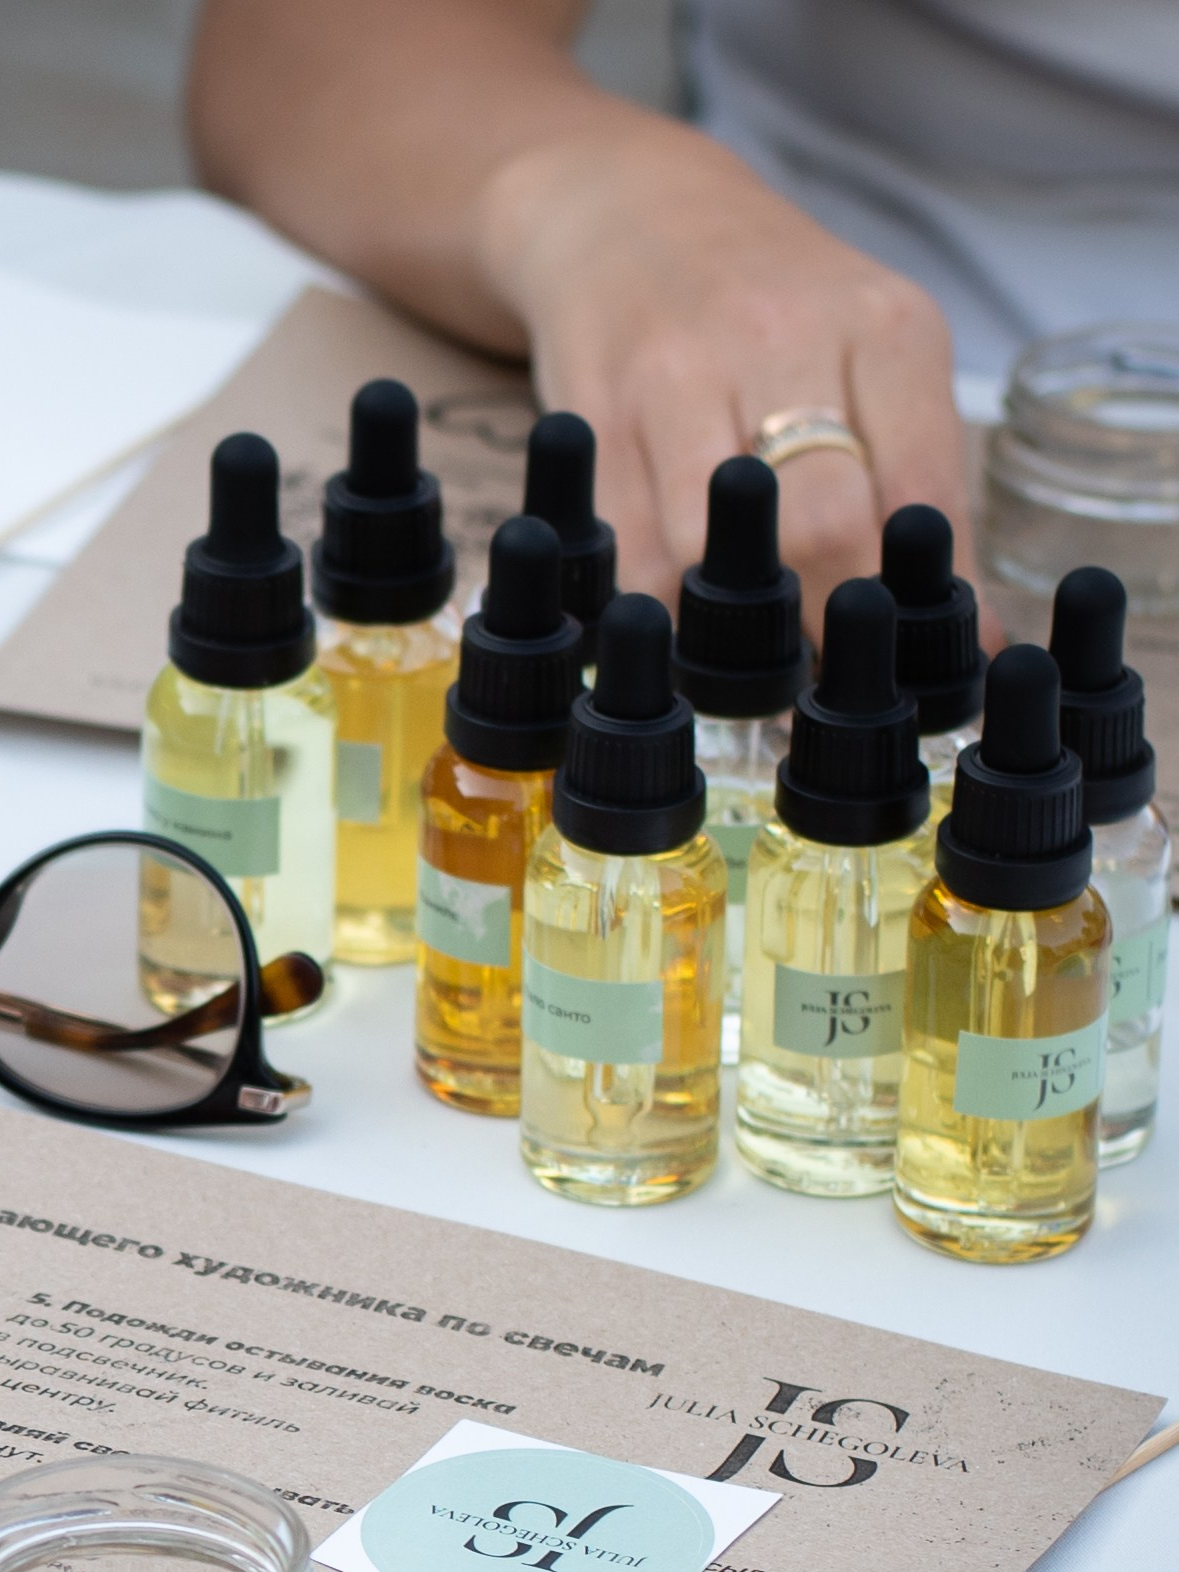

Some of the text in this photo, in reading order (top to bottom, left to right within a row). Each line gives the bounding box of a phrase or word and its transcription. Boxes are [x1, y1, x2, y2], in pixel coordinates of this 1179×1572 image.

[546, 1003, 592, 1025] санто
[823, 989, 871, 1048] JS
[1032, 1047, 1077, 1112] JS
[171, 1250, 428, 1323] художника
[436, 1313, 492, 1338] по
[502, 1330, 666, 1378] свечам
[5, 1313, 423, 1416] до 50 градусов и заливай
[16, 1336, 209, 1391] подсвечник.
[25, 1291, 518, 1416] 5. Подожди остывания воска
[0, 1377, 116, 1414] центру.
[183, 1398, 302, 1435] фитиль
[645, 1392, 972, 1474] JULIA SCHEGOLEVA
[705, 1375, 911, 1489] JS
[273, 1486, 355, 1515] вать
[430, 1504, 650, 1568] JULIA SCHEGOLEVA
